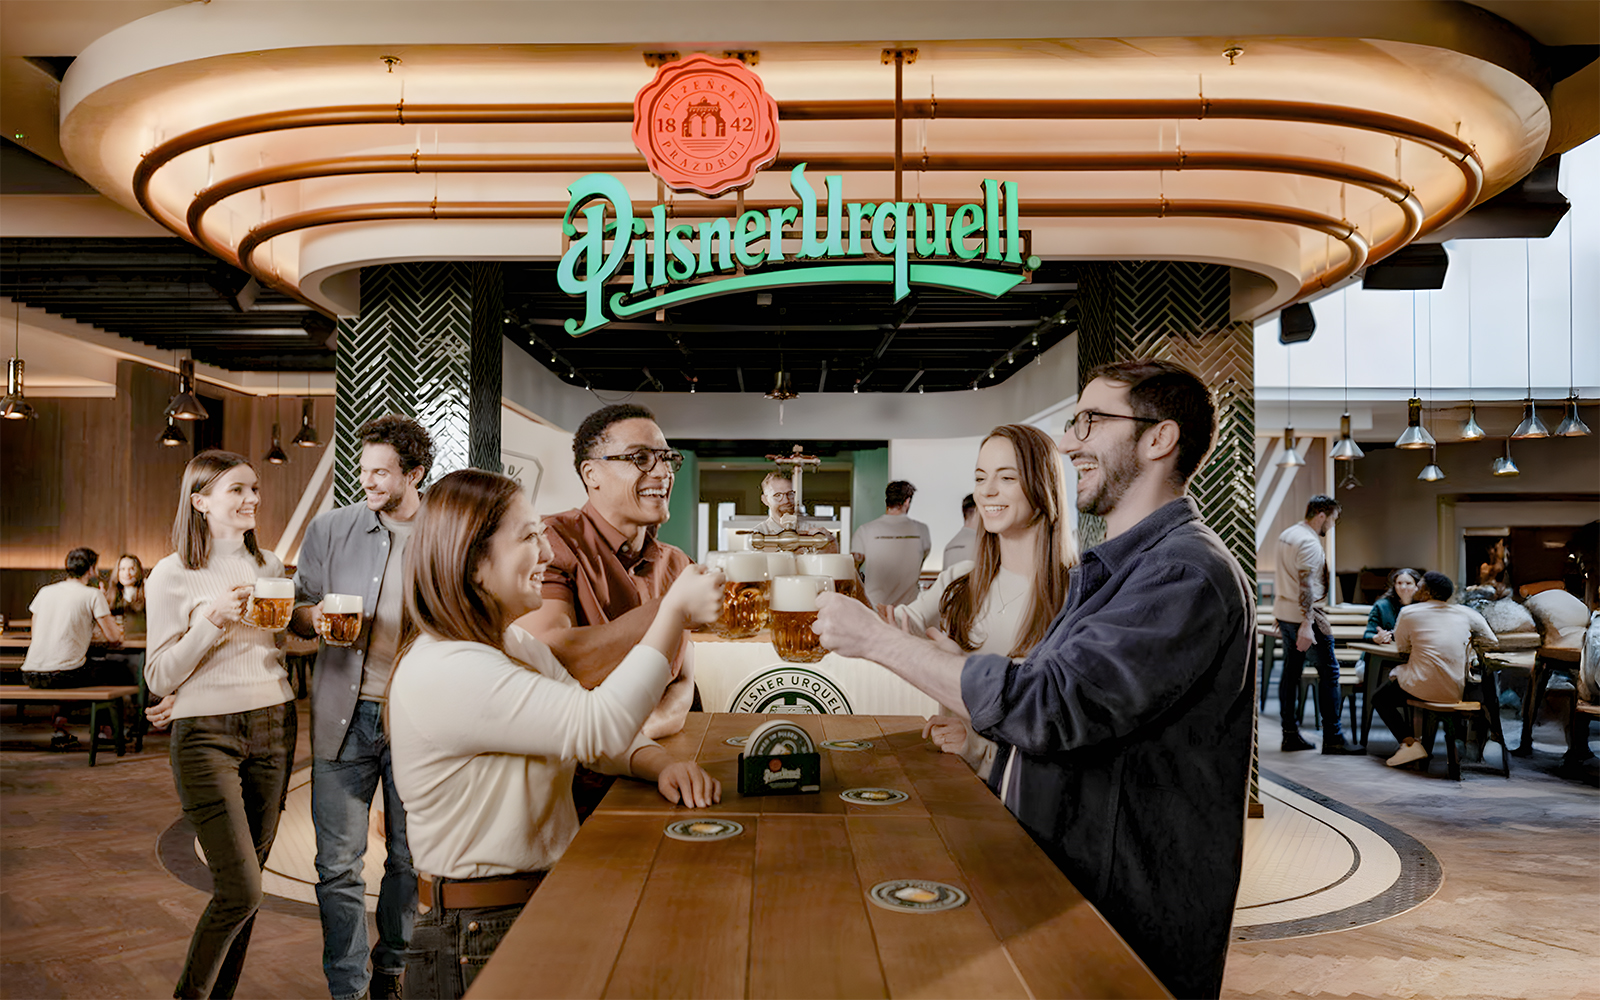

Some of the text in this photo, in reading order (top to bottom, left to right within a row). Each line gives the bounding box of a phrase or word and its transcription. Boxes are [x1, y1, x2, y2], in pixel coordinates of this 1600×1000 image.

[657, 116, 754, 133] 18 42
[662, 140, 746, 172] PRAZDROJ
[557, 172, 799, 337] Pilsner
[740, 676, 841, 713] ILSNER URQUEL
